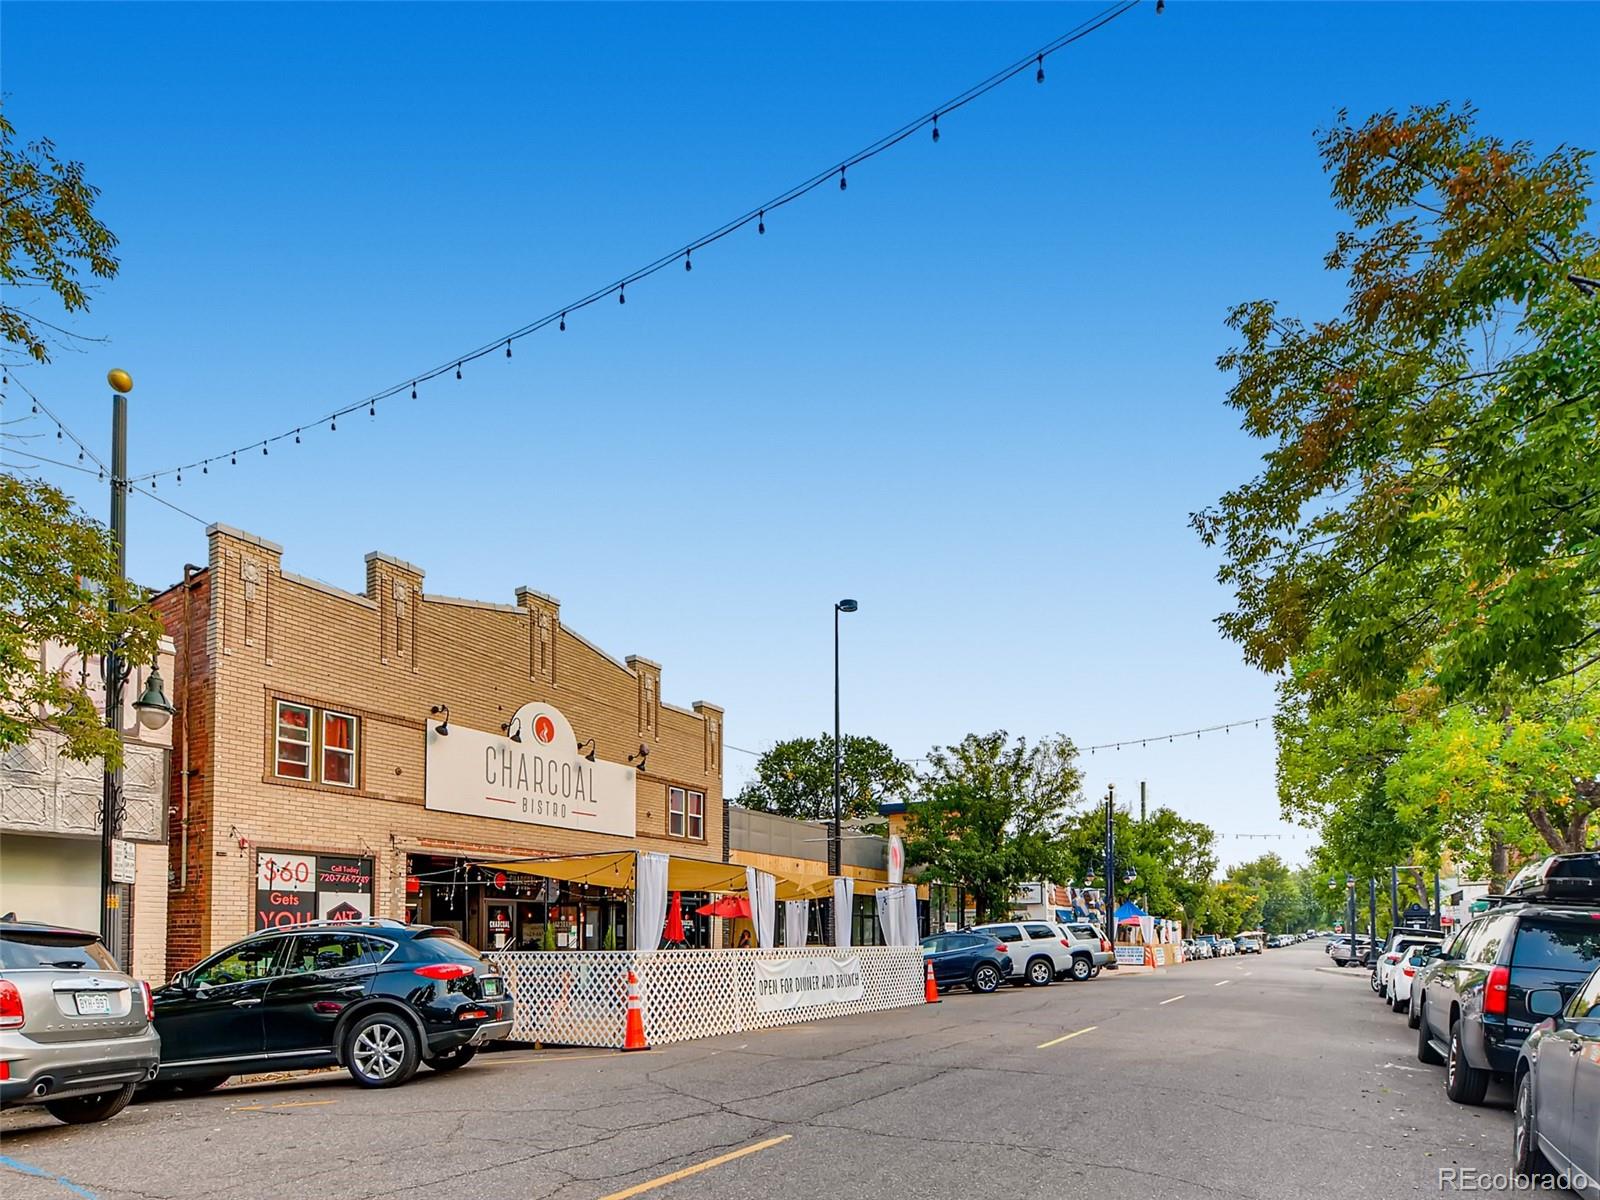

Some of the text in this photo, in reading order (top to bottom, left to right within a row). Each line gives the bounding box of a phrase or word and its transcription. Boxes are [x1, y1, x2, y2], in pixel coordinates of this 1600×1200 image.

[485, 746, 598, 803] CHARCOAL
[522, 797, 566, 818] BISTRO
[263, 857, 309, 883] $60
[343, 866, 359, 875] Today
[270, 892, 299, 905] Gets
[259, 911, 312, 931] YOU
[759, 972, 860, 995] OPEN FOR DINNER AND BRUNCH
